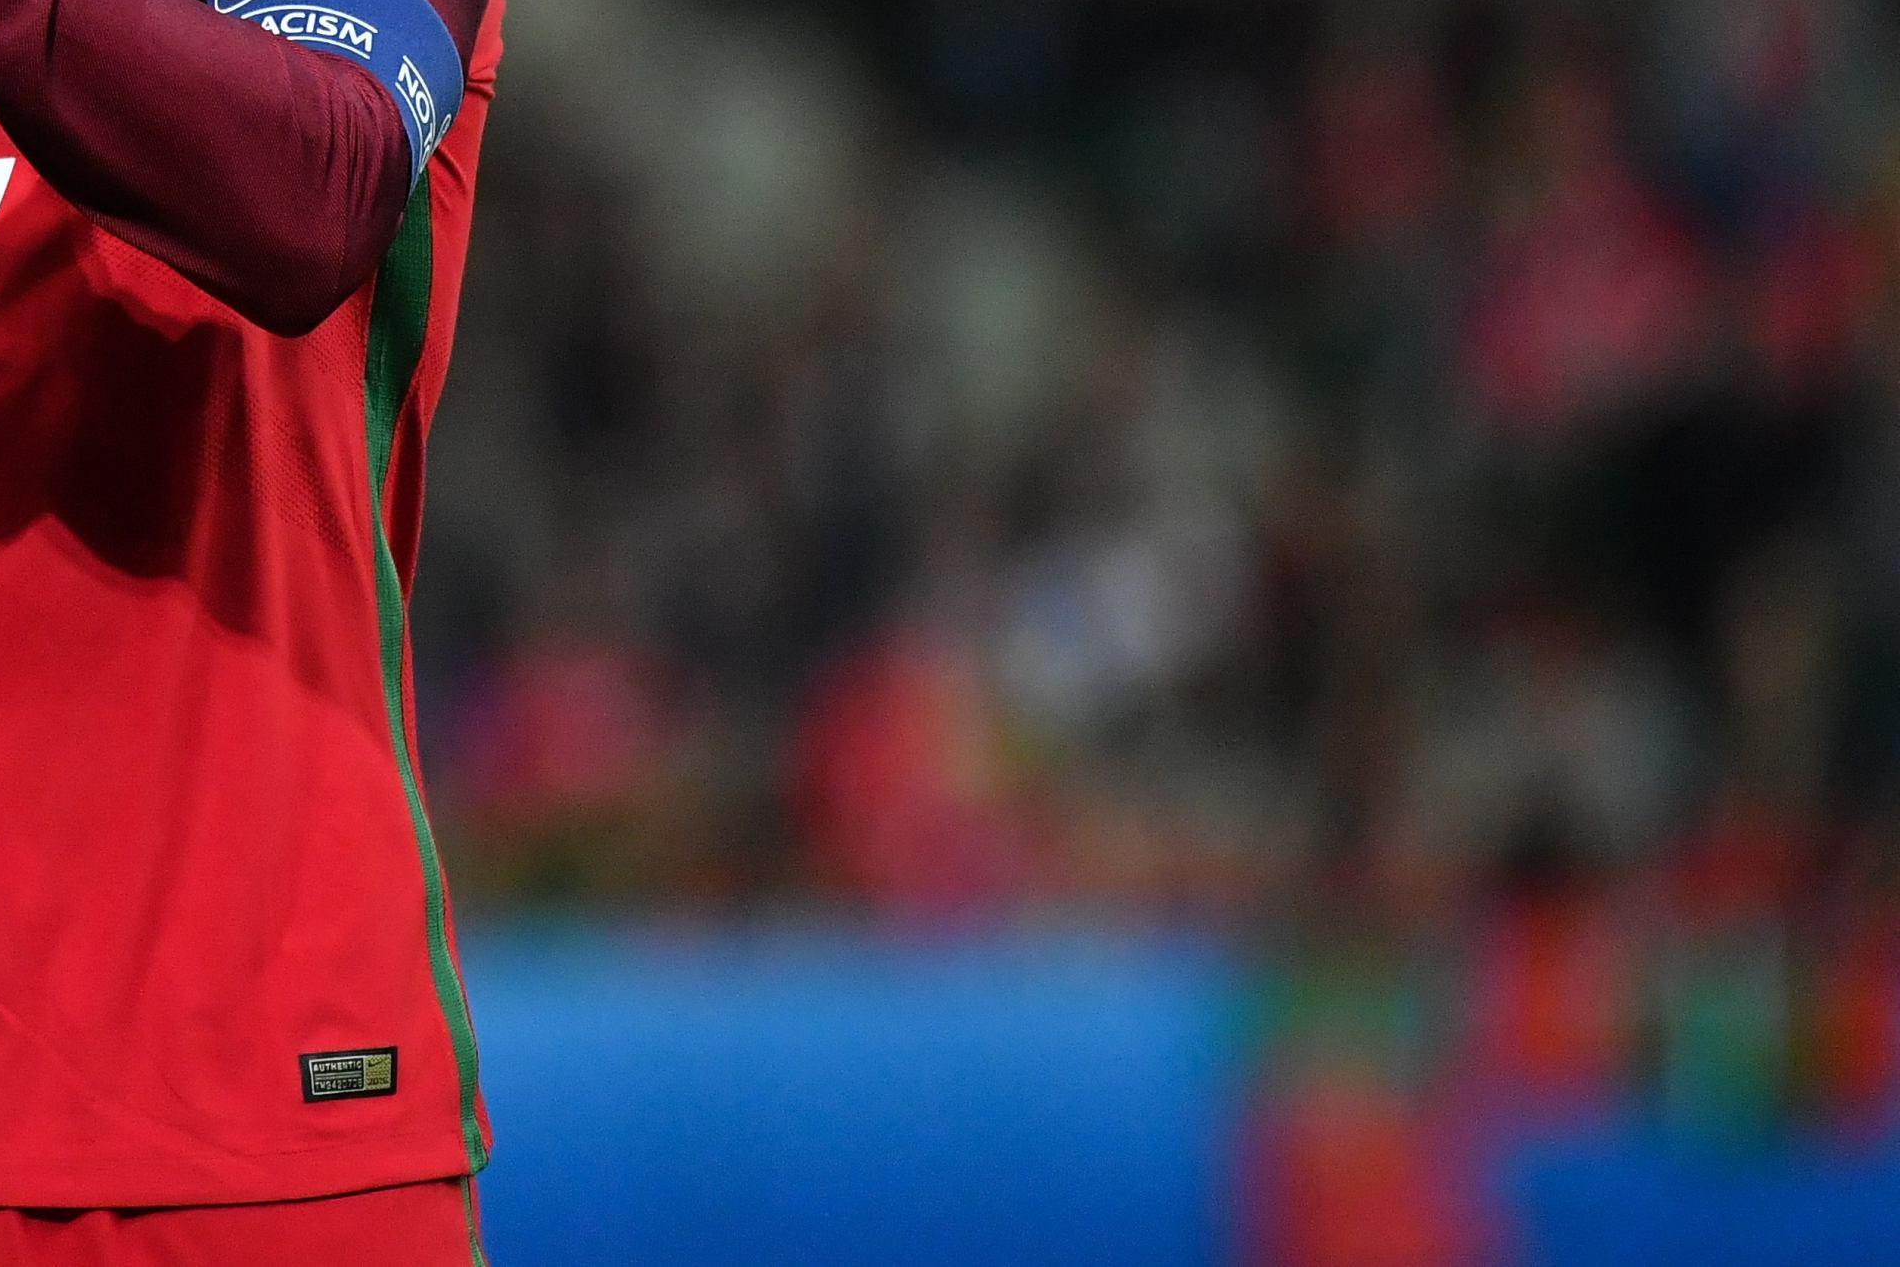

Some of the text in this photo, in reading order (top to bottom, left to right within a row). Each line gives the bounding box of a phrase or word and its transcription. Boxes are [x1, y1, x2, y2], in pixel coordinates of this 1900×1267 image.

[261, 11, 373, 52] ACISM
[398, 62, 430, 124] NO
[313, 1060, 362, 1072] AUTHENTIC
